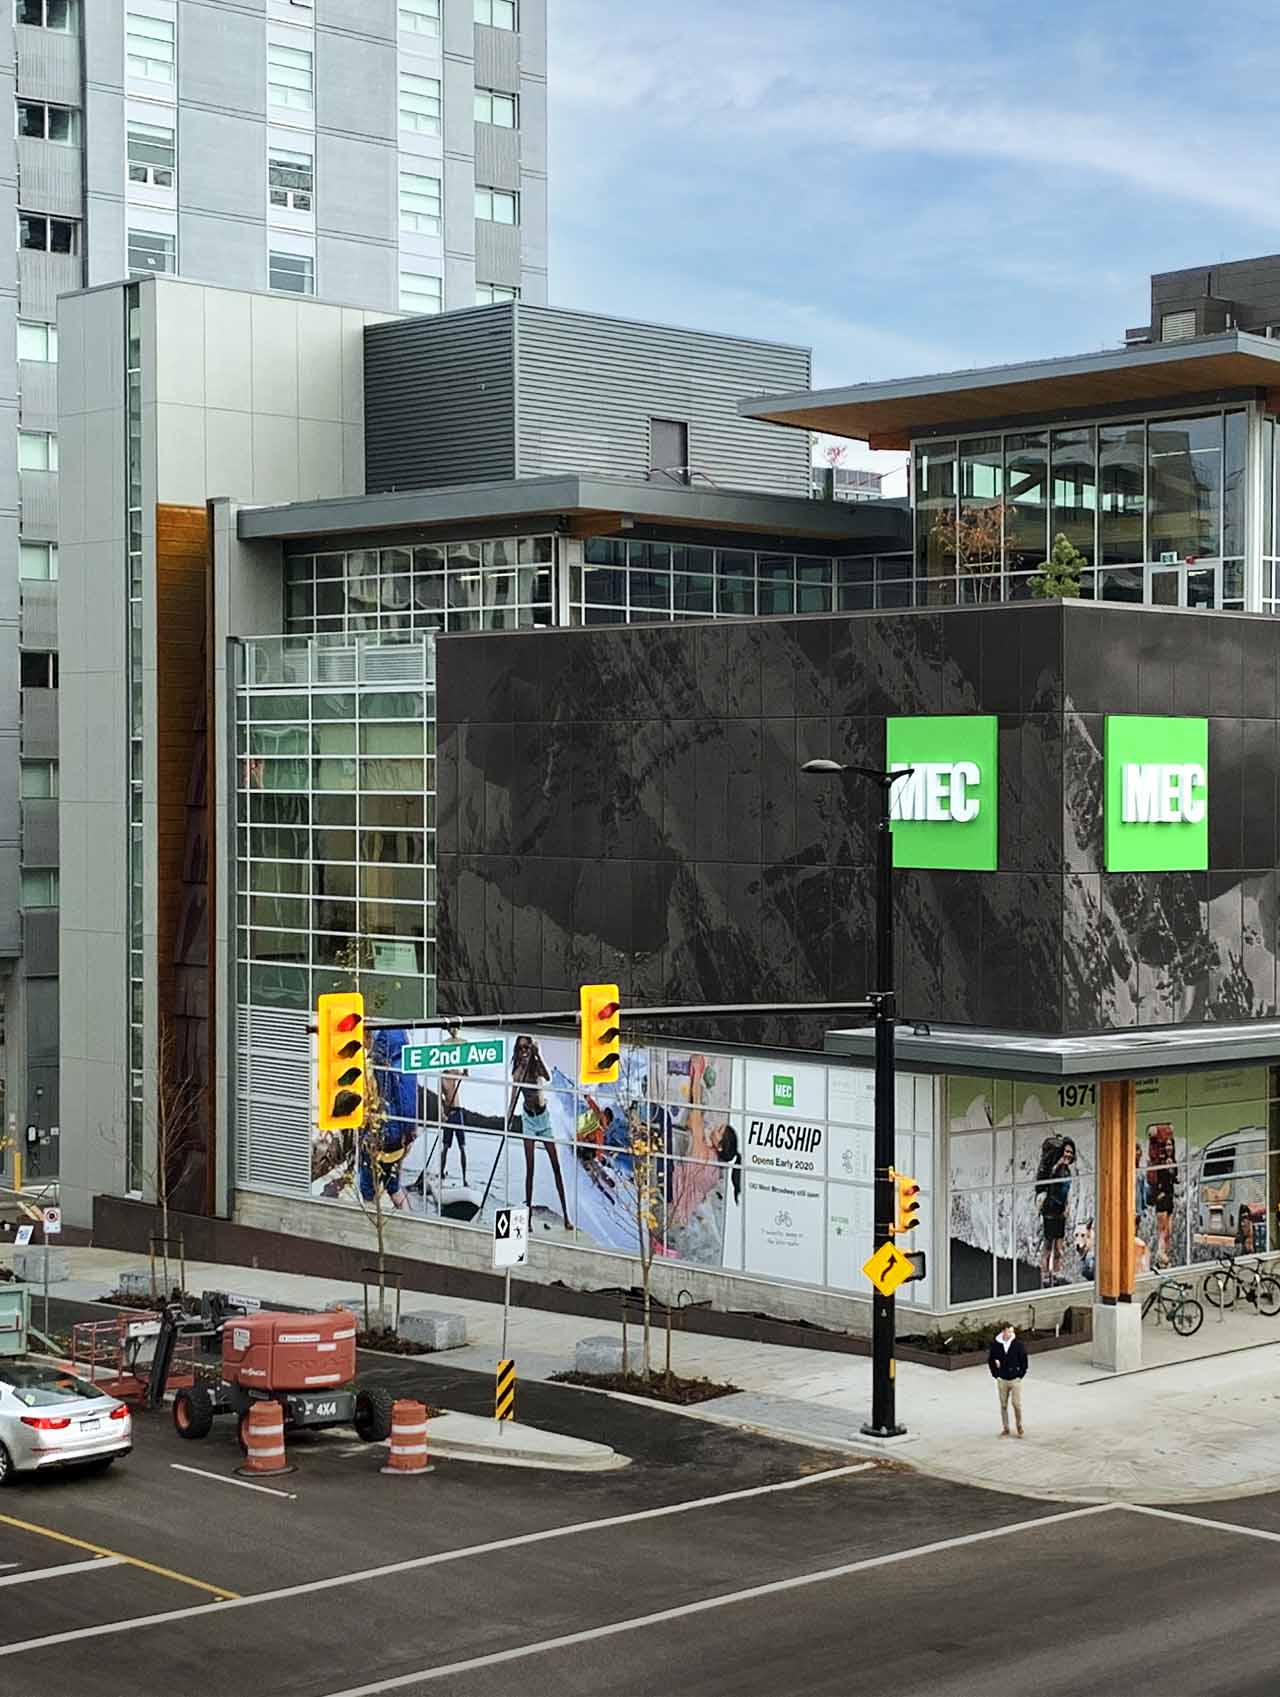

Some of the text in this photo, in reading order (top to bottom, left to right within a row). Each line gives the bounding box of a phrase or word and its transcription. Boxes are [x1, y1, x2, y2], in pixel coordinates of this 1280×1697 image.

[888, 761, 981, 823] MEC
[1120, 763, 1205, 824] MEC
[410, 1045, 497, 1067] E 2nd Ave
[774, 1083, 793, 1098] MEC
[1058, 1083, 1096, 1107] 1971
[748, 1121, 822, 1153] FLAGSHIP
[752, 1154, 815, 1171] Opens Early 2020
